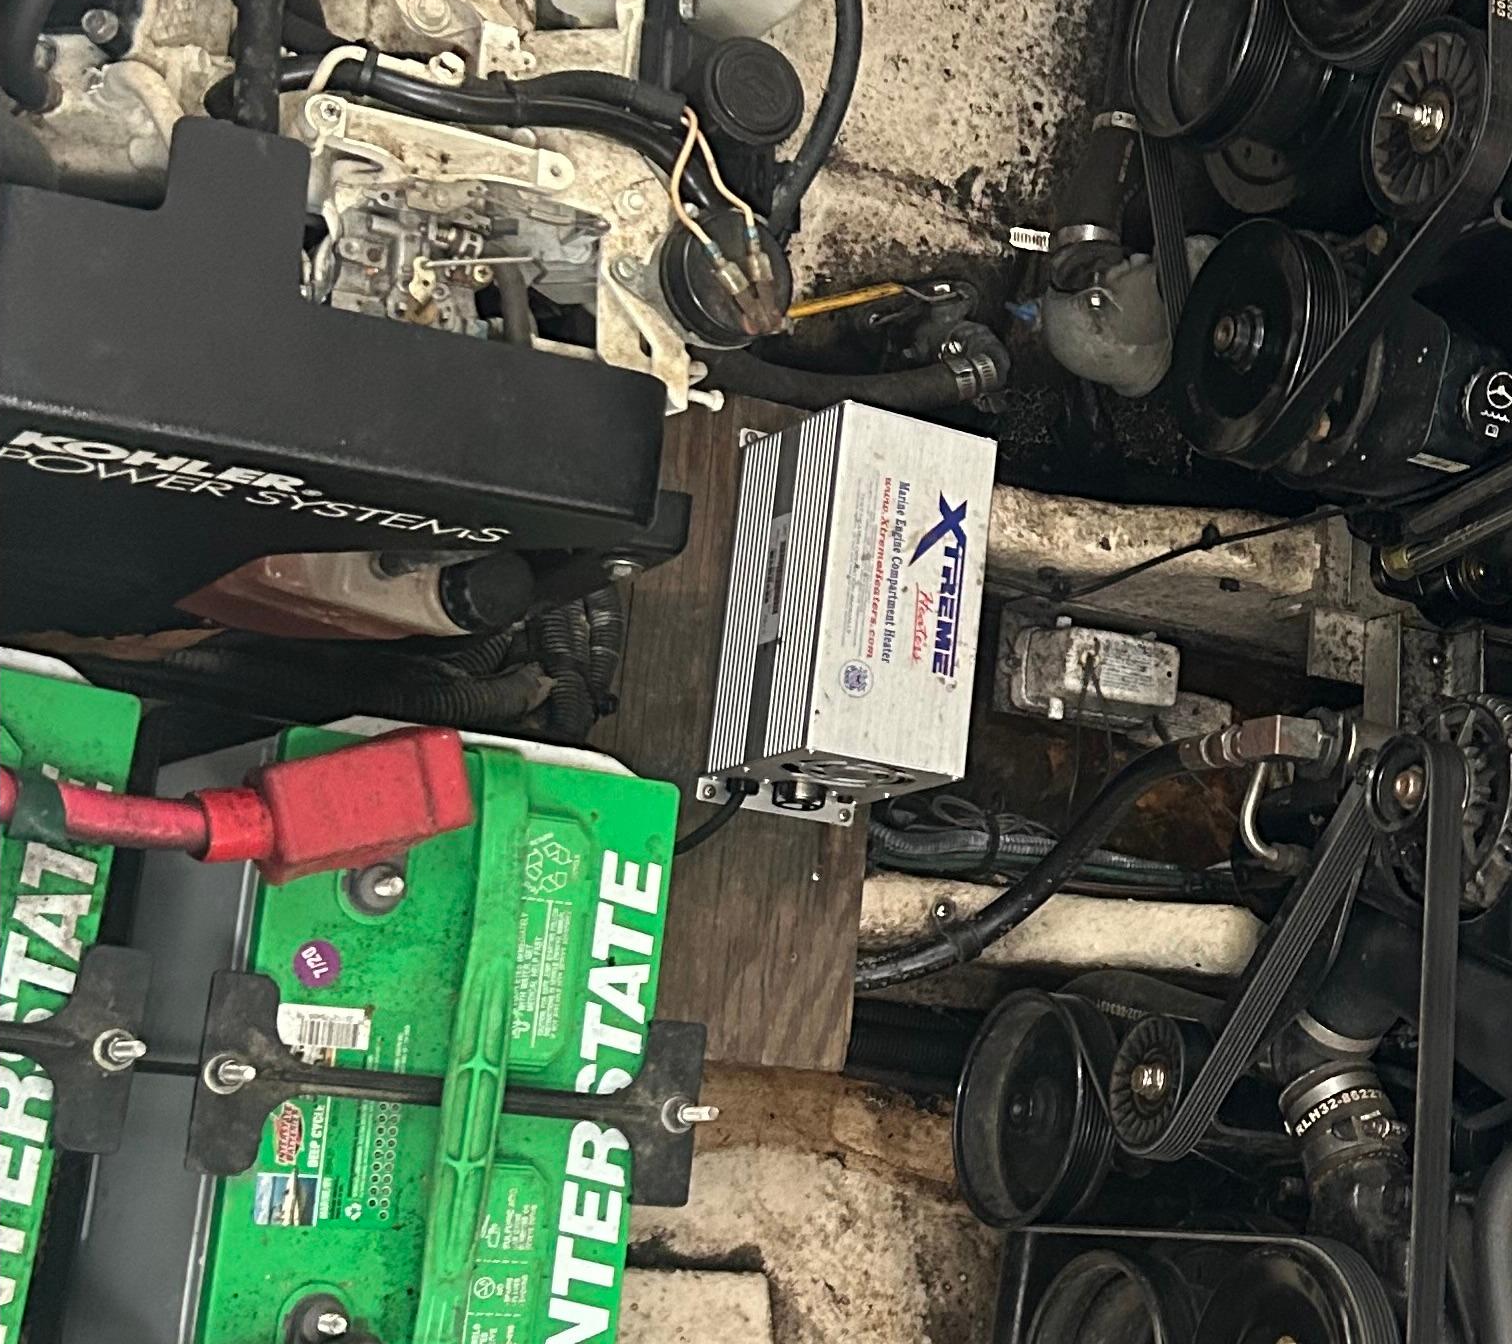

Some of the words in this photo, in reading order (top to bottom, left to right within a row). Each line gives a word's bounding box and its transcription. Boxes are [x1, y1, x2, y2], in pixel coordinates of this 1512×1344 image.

[245, 490, 511, 543] SYSTEMS
[895, 480, 910, 516] Marine
[889, 518, 906, 554] Engine
[865, 476, 893, 659] www.XtremeHeaters.com
[908, 489, 968, 678] XTREME
[882, 554, 903, 627] Compartment
[880, 628, 895, 664] Heater
[910, 588, 935, 666] Heaters
[309, 1104, 325, 1138] CYCLE
[306, 1140, 320, 1167] DEEP
